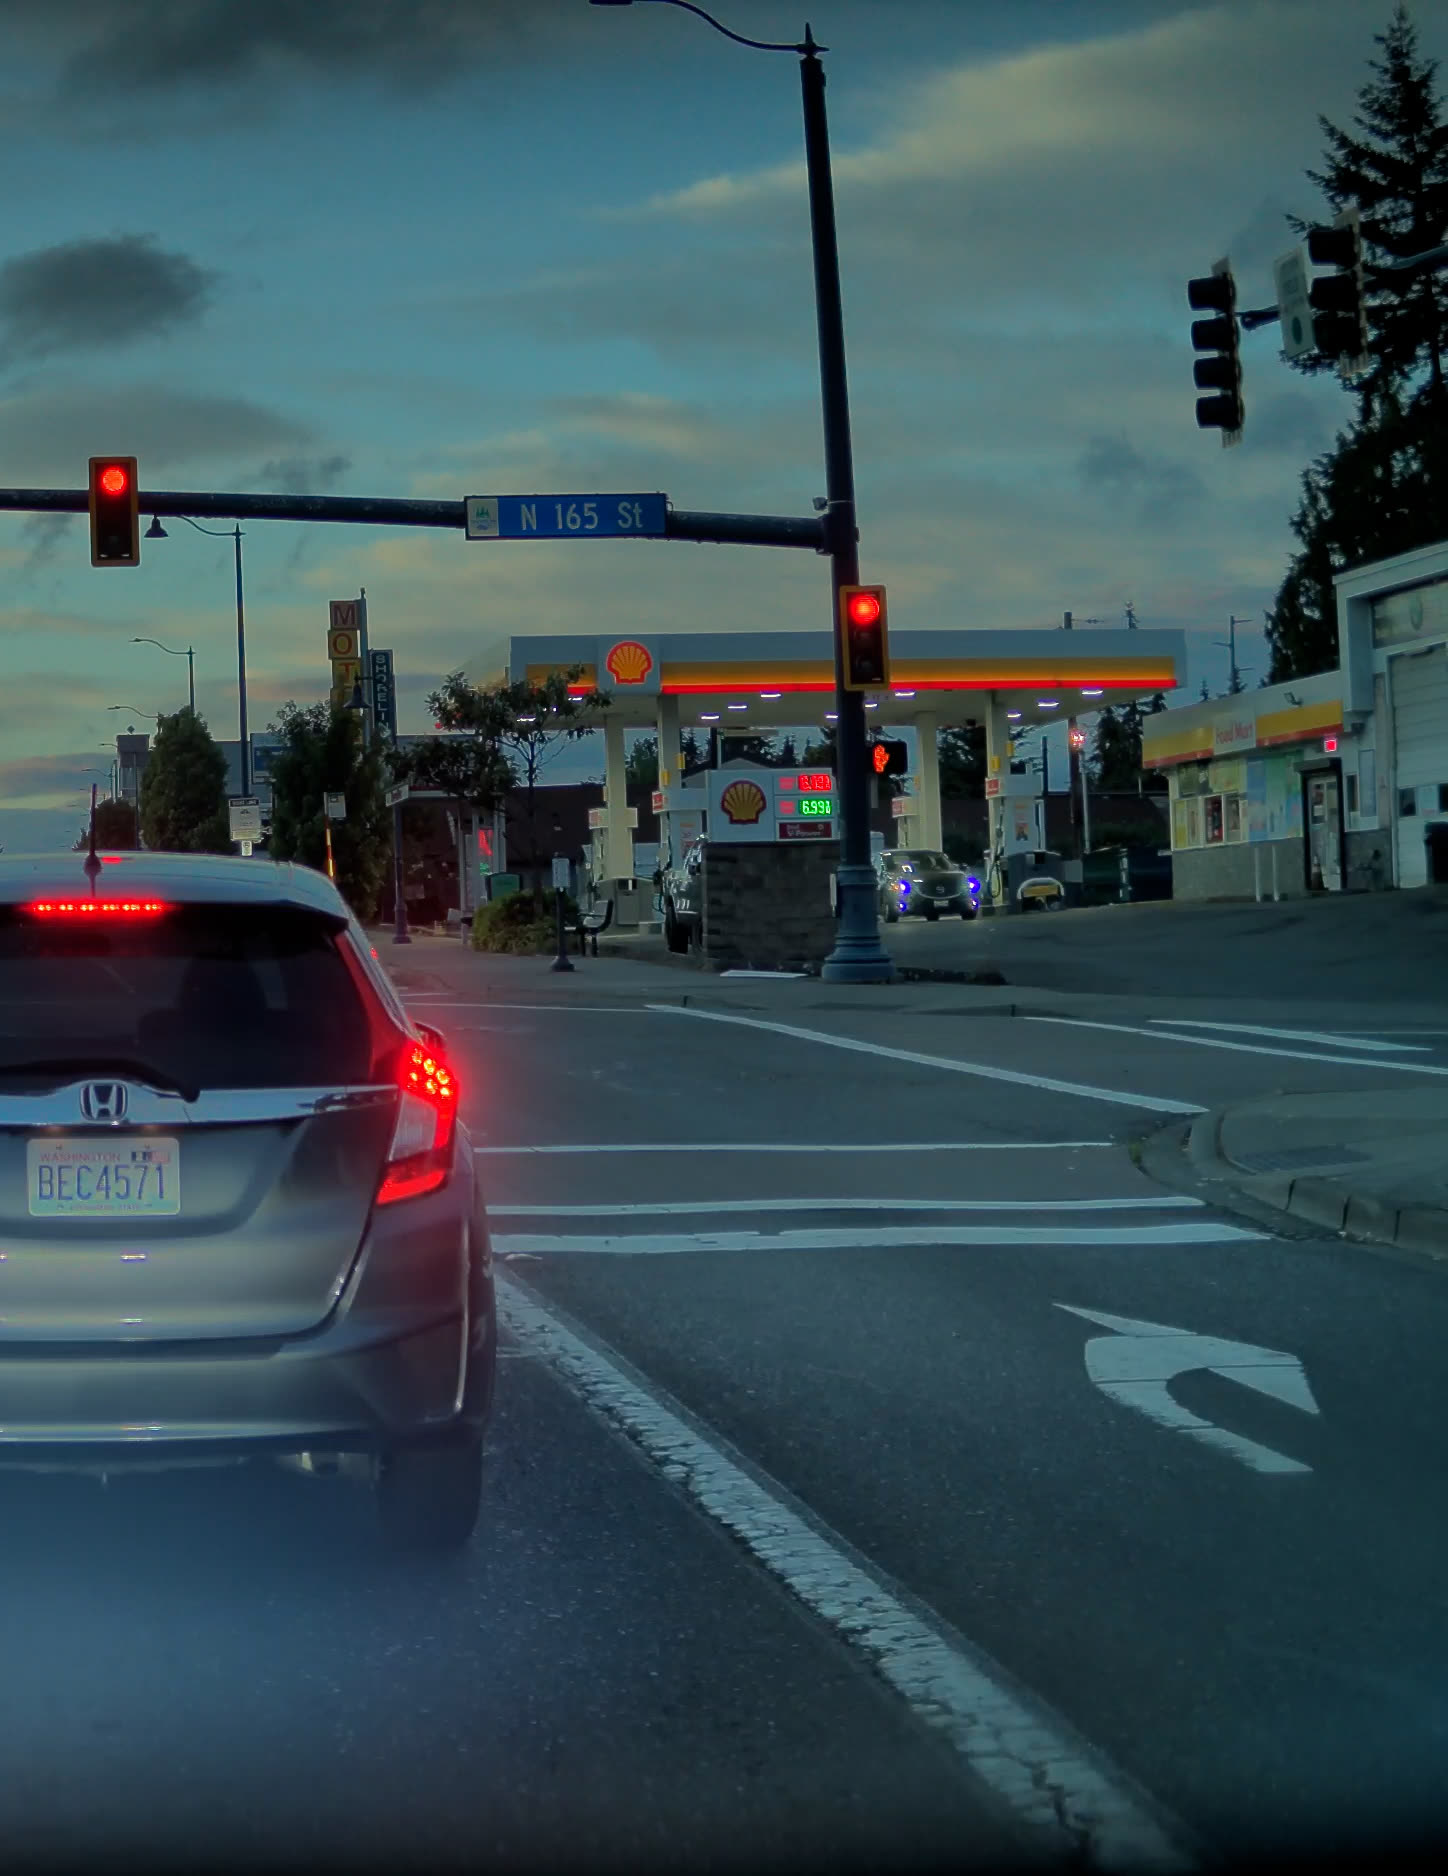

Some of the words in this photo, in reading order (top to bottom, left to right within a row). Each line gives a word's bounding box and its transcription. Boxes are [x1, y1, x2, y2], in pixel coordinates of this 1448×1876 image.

[520, 503, 537, 531] N
[555, 503, 599, 530] 165
[617, 501, 644, 529] St
[40, 1151, 120, 1163] WASHINGTON
[38, 1163, 165, 1201] BEC4571
